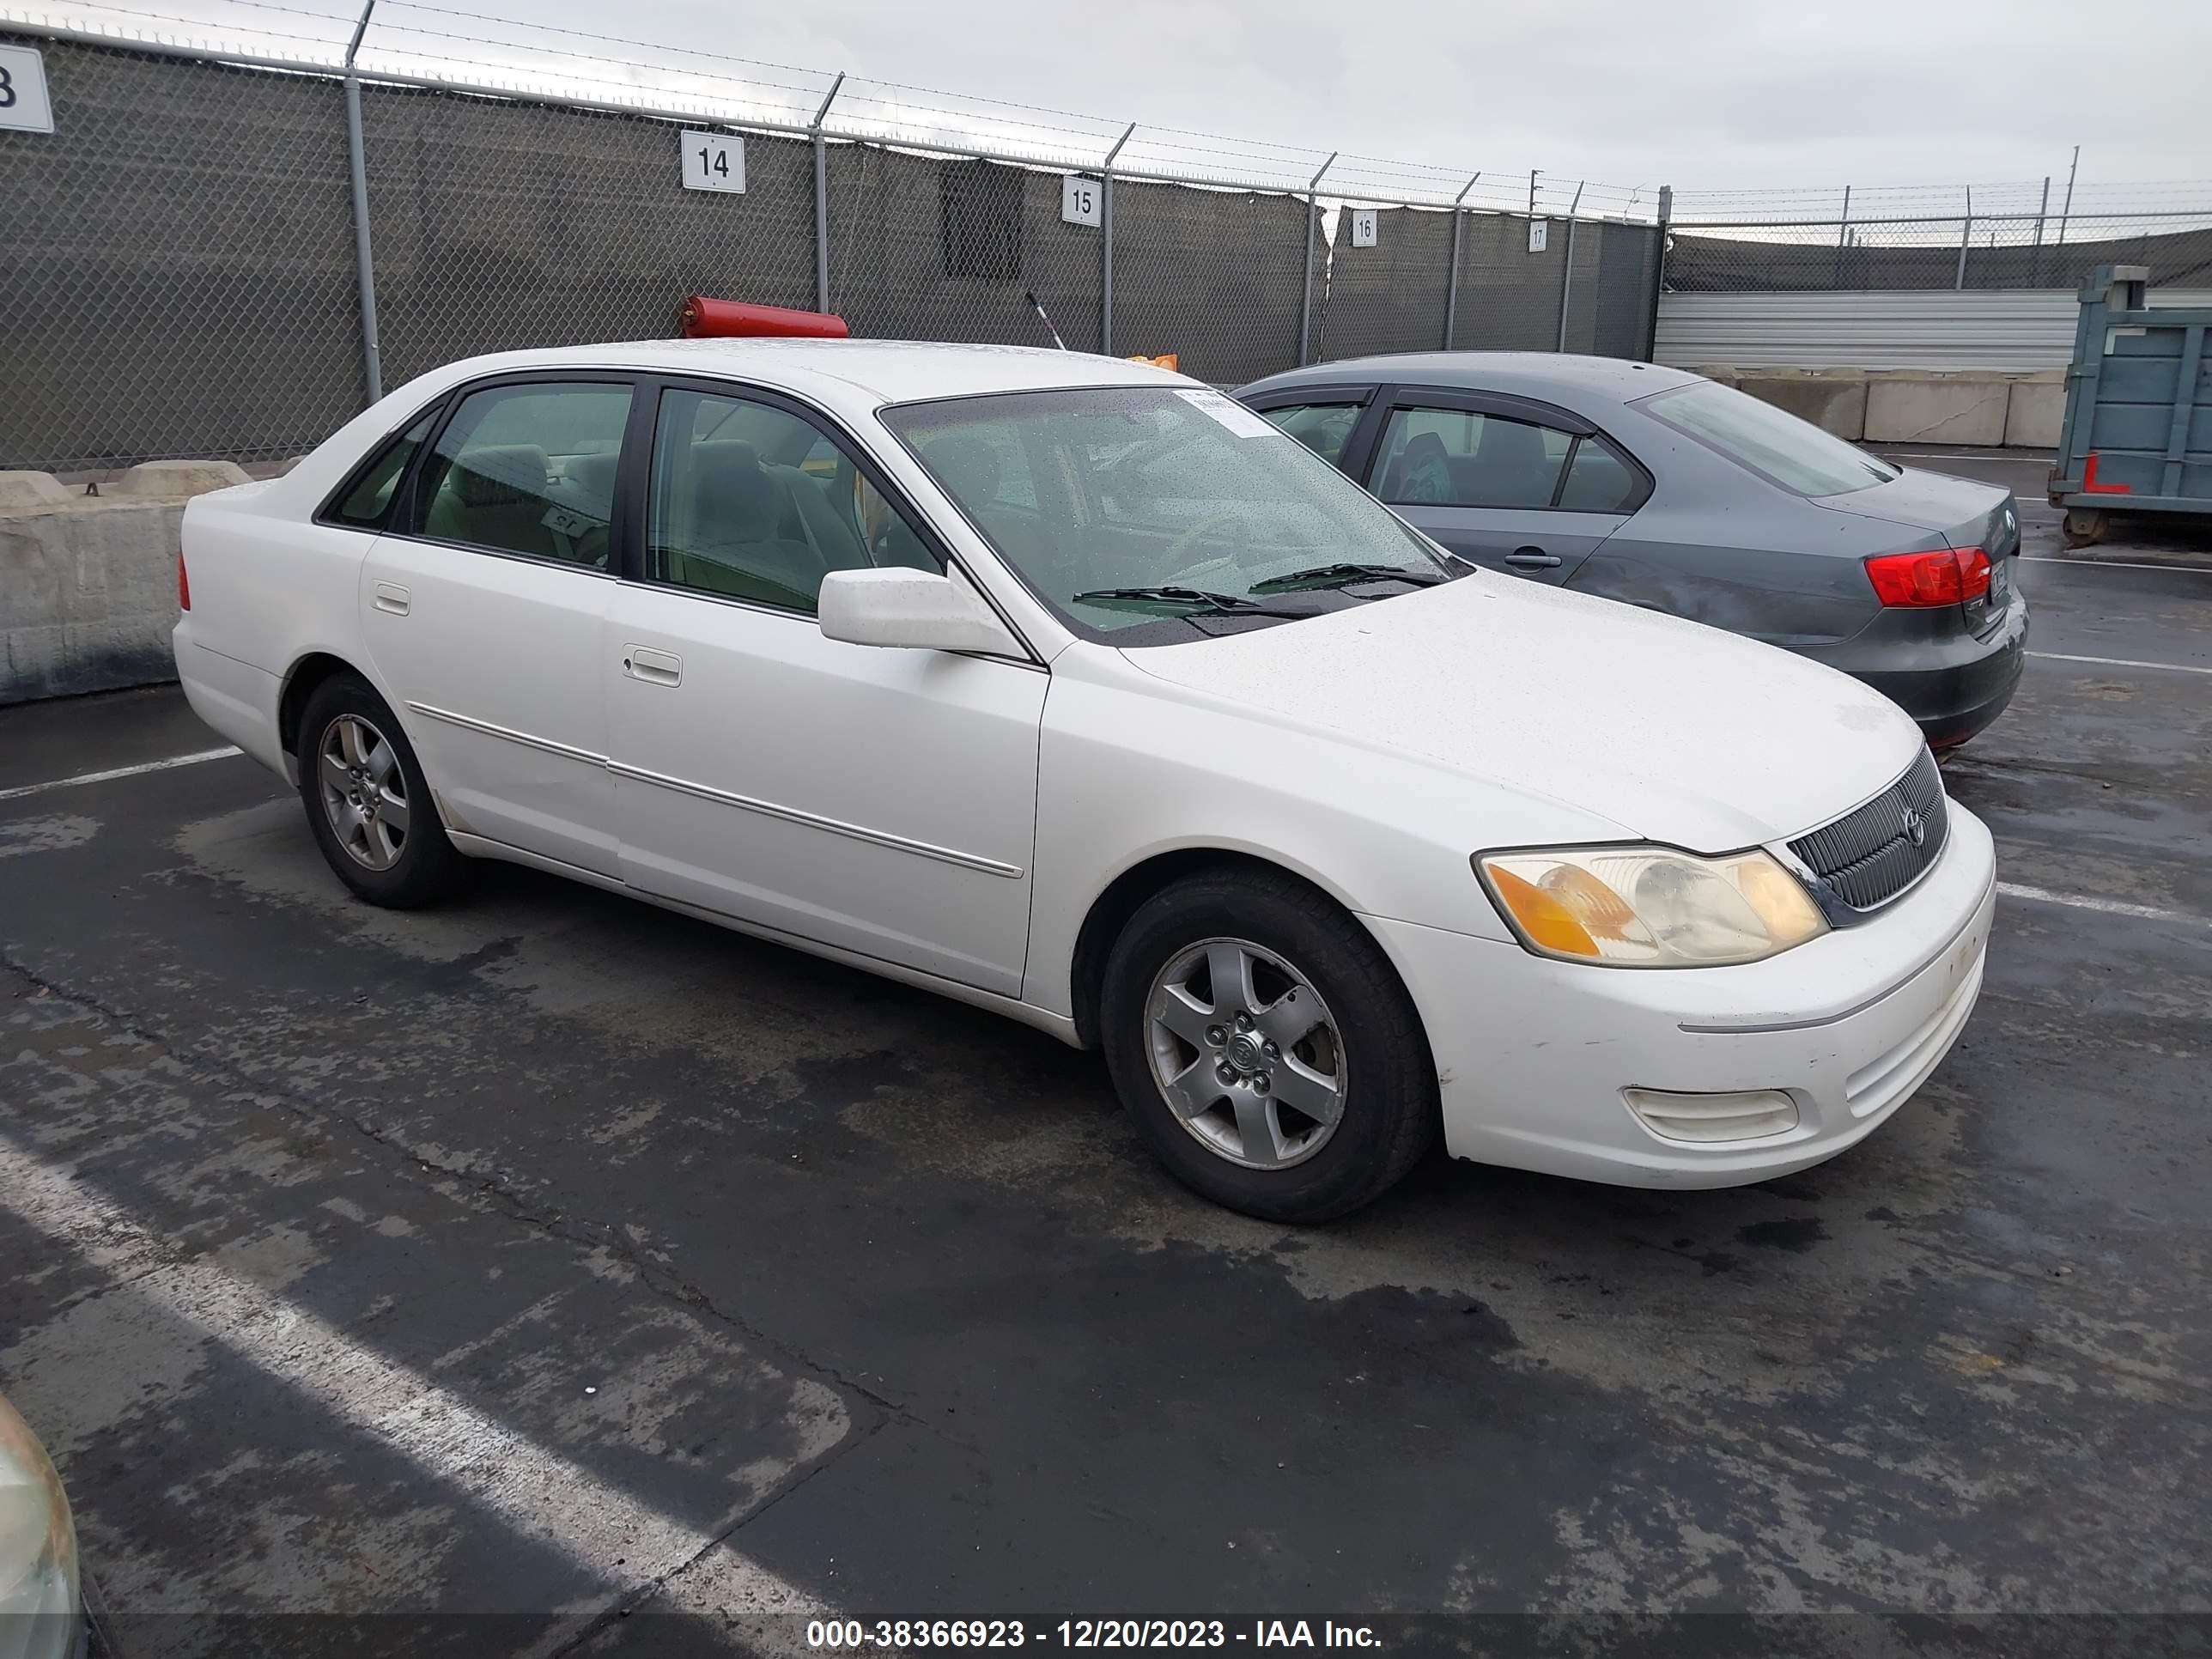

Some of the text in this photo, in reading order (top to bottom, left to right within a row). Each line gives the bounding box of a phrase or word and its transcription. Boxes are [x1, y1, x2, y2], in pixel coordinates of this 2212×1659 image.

[698, 147, 730, 179] 14
[1073, 189, 1091, 215] 15
[1359, 219, 1371, 238] 16
[1534, 229, 1543, 245] 17
